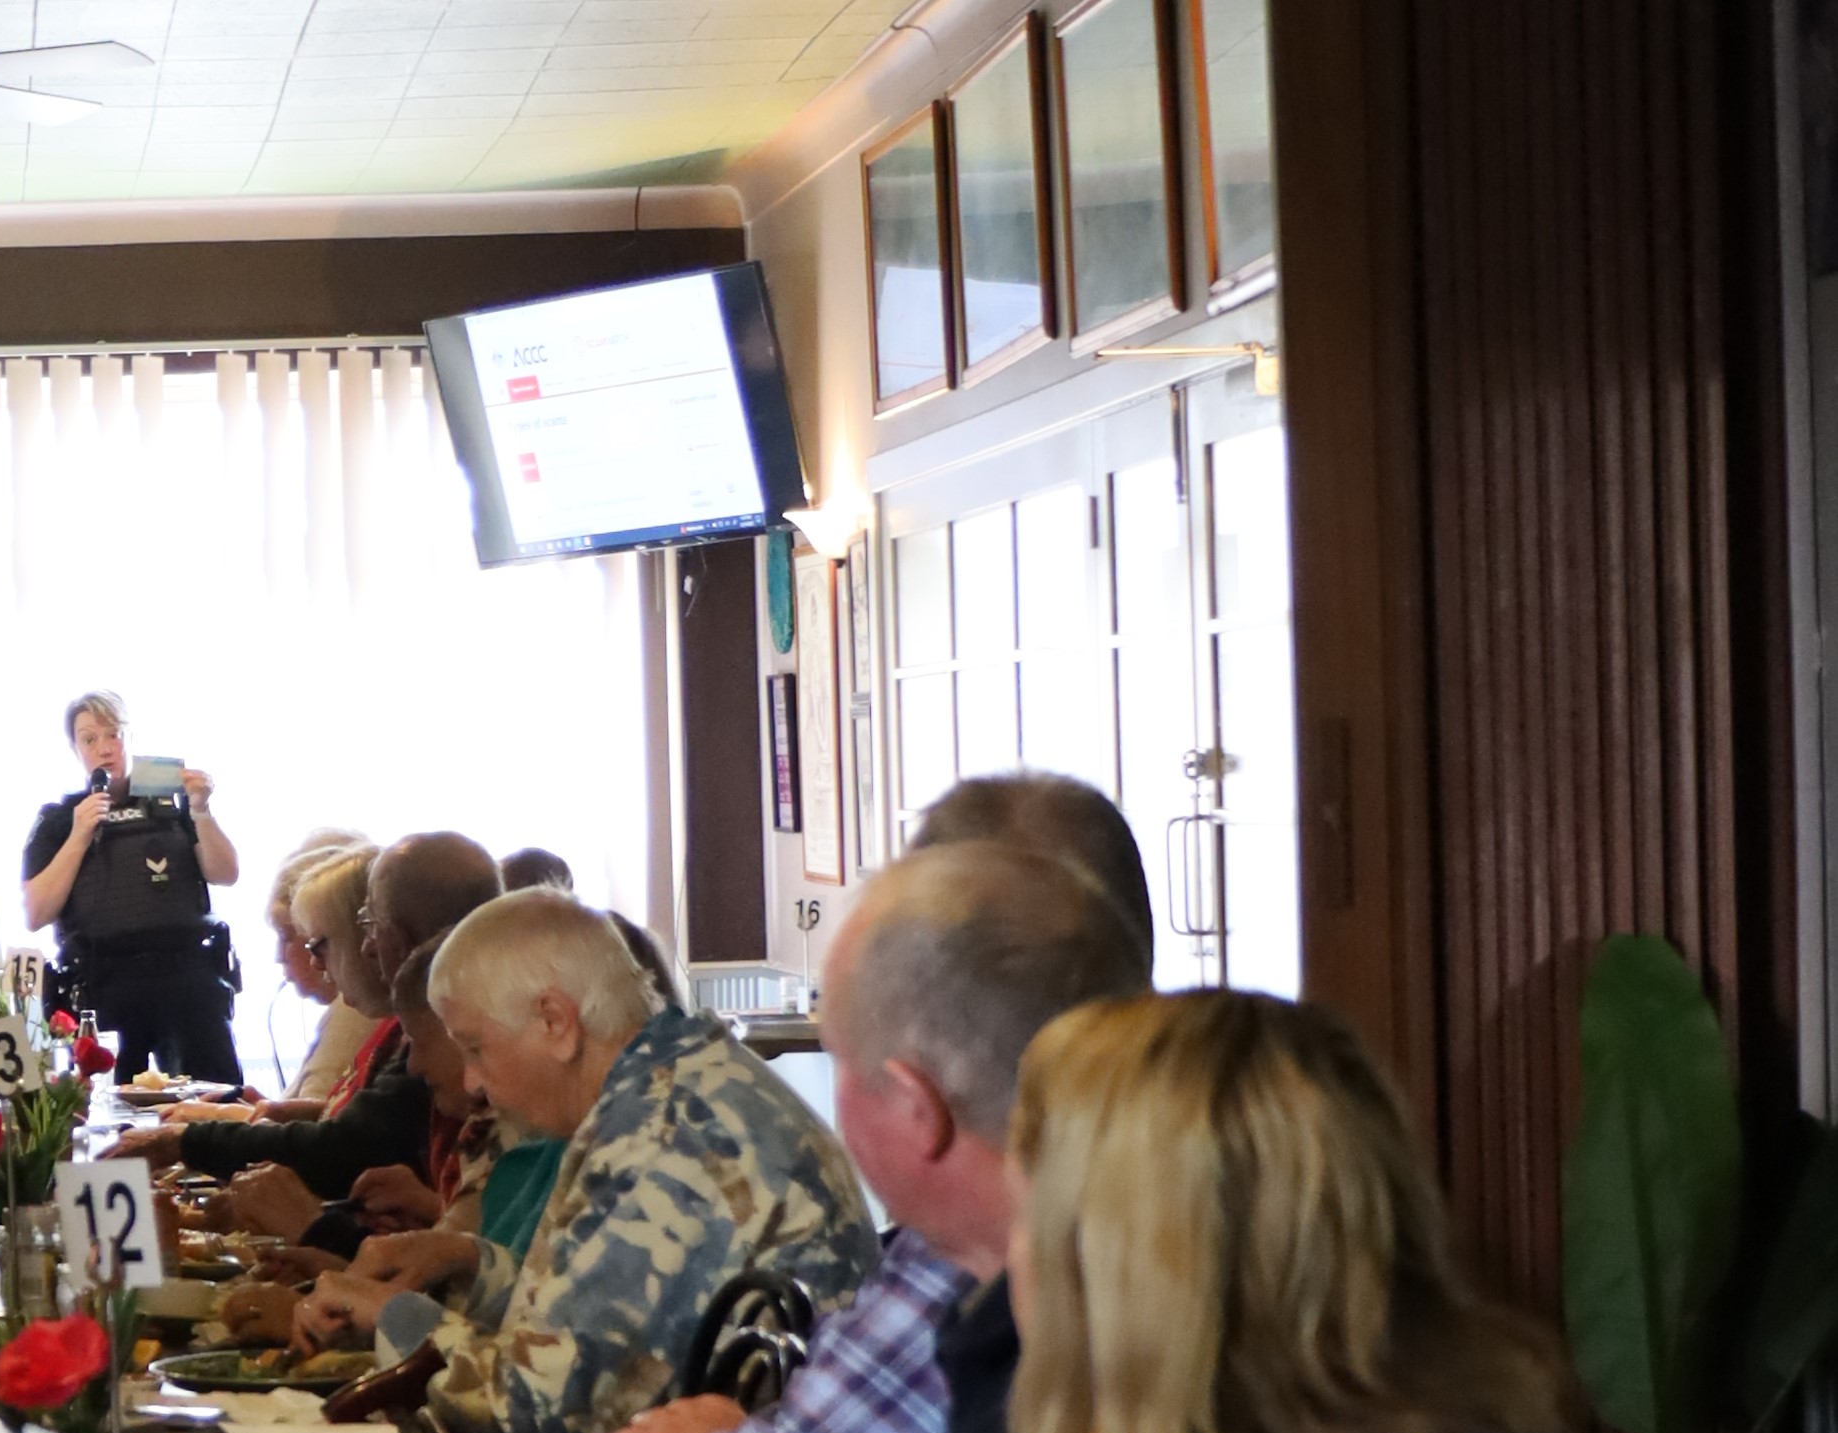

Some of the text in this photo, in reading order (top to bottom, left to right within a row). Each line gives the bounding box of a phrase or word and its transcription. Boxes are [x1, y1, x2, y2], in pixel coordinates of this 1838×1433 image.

[513, 345, 548, 368] ACCC
[107, 808, 143, 822] OLICE
[794, 898, 820, 926] 16
[13, 954, 37, 988] 15
[74, 1181, 144, 1264] 12
